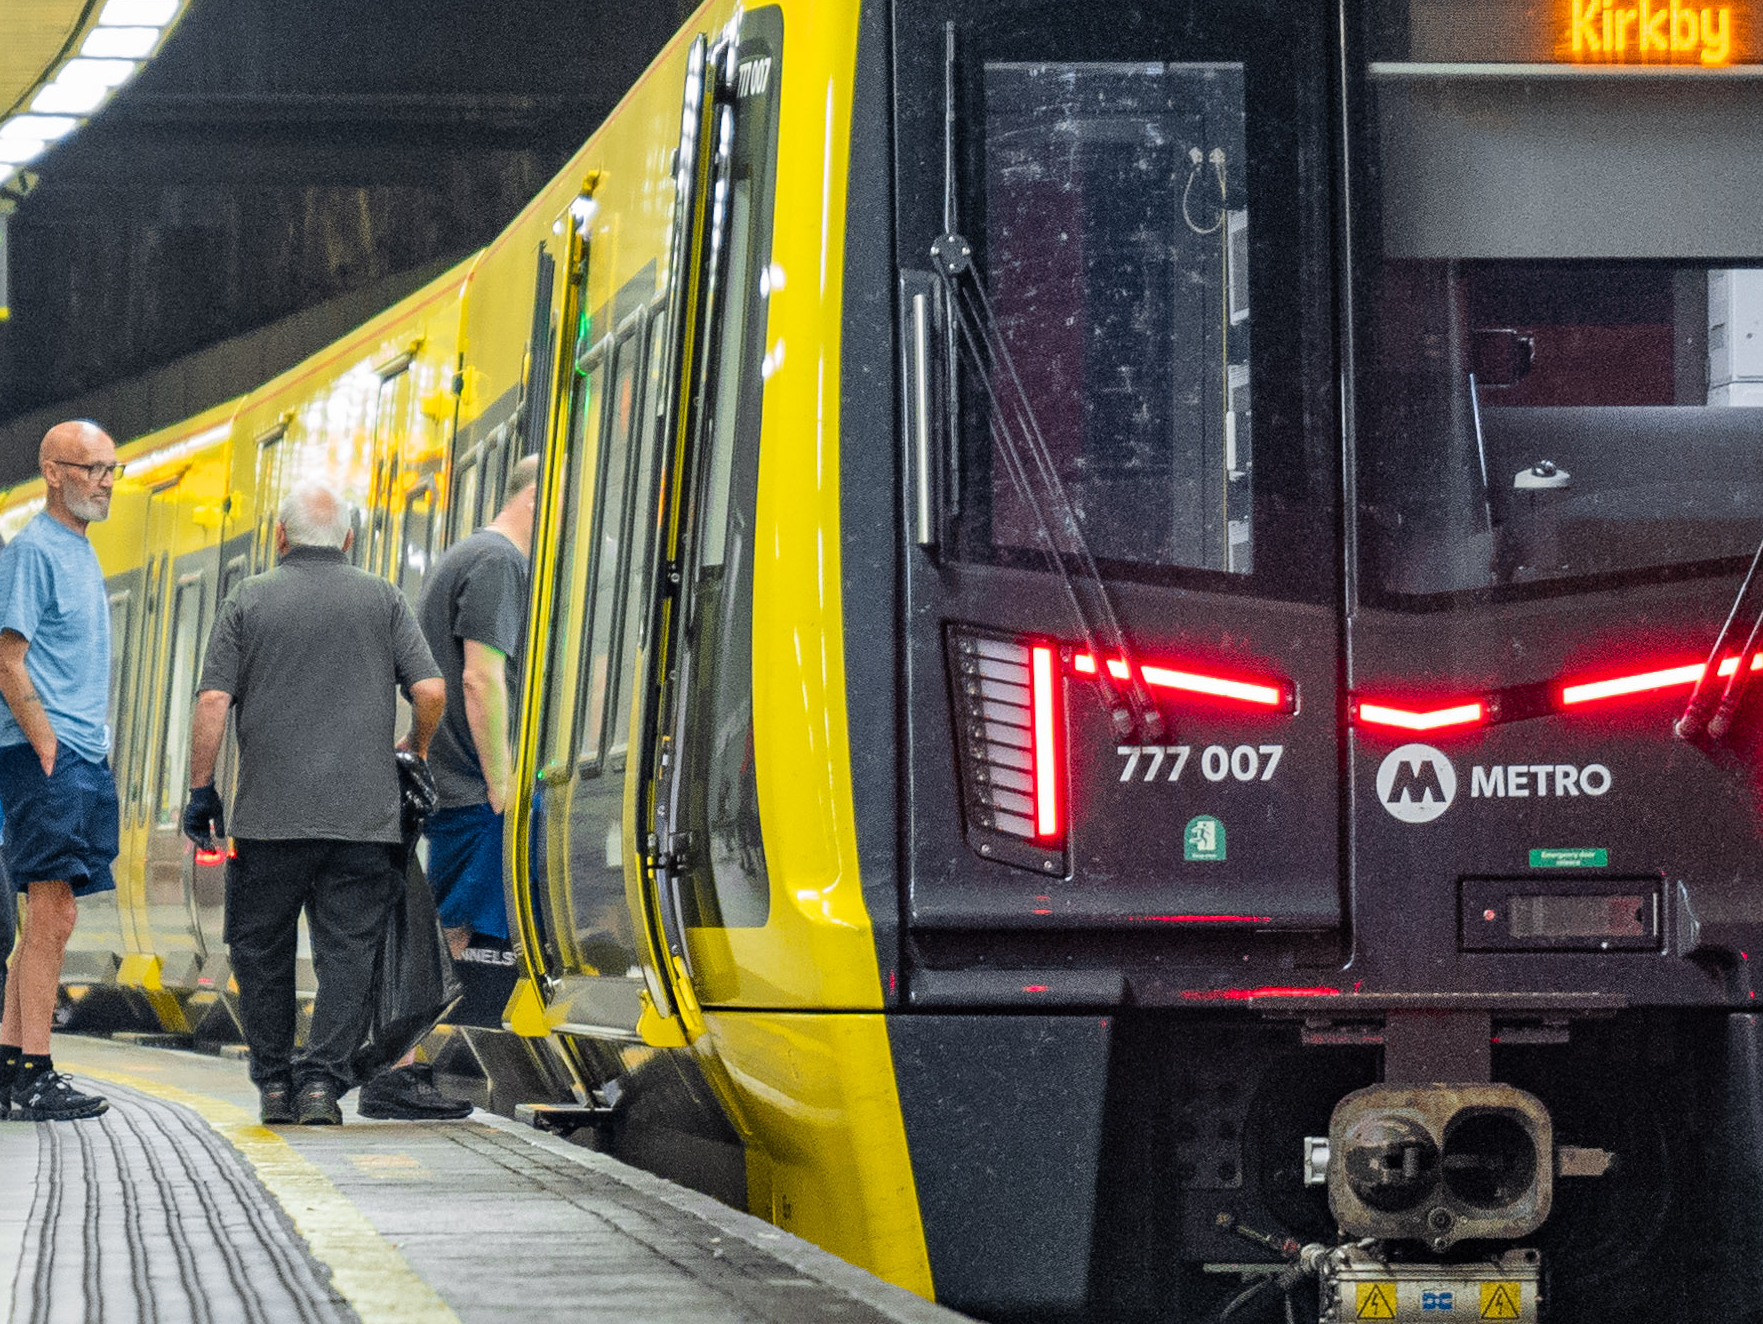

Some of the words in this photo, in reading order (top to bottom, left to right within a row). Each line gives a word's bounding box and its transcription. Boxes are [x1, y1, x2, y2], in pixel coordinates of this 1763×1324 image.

[737, 59, 753, 98] 777
[750, 56, 773, 96] 007
[1117, 744, 1191, 782] 777
[1201, 744, 1284, 782] 007
[1470, 763, 1613, 798] METRO
